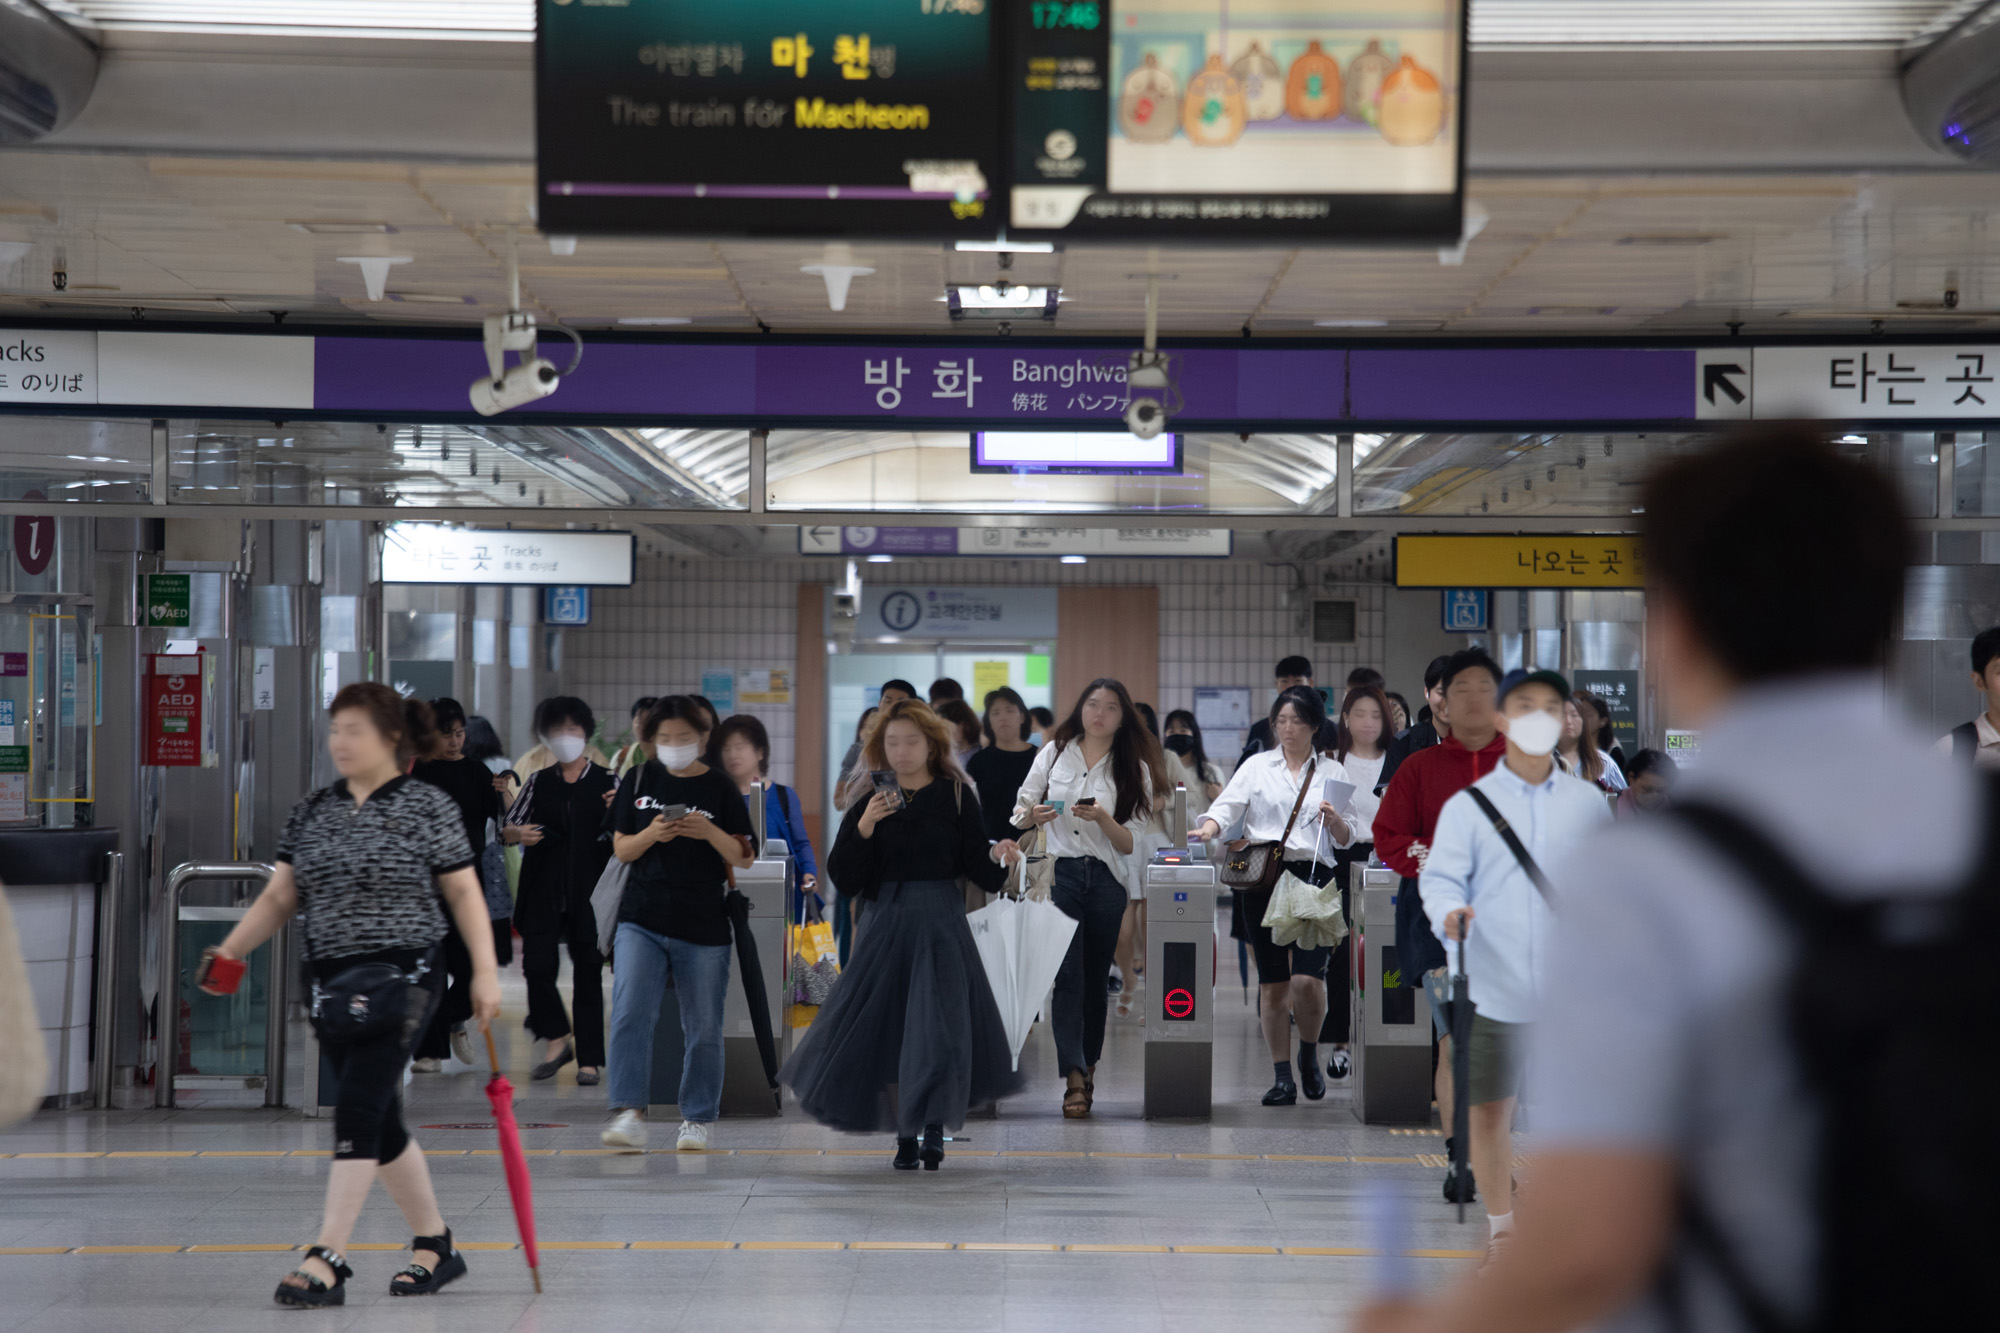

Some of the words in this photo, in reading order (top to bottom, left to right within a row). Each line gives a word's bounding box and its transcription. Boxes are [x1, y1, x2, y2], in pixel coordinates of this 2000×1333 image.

[610, 97, 660, 127] The
[669, 98, 736, 127] train
[743, 98, 787, 128] for
[795, 97, 930, 130] Macheon
[1012, 359, 1127, 387] Banghwa
[1830, 352, 1926, 405] 타는
[1945, 353, 1994, 405] 곳
[21, 374, 83, 392] のりば
[1067, 393, 1131, 411] パンファ
[413, 546, 459, 570] 타는
[468, 546, 492, 571] 곳
[504, 545, 542, 557] Tracks
[1518, 549, 1590, 575] 나오는
[1599, 550, 1623, 575] 곳
[165, 609, 188, 618] AED
[1617, 683, 1627, 696] 곳
[158, 694, 195, 705] AED
